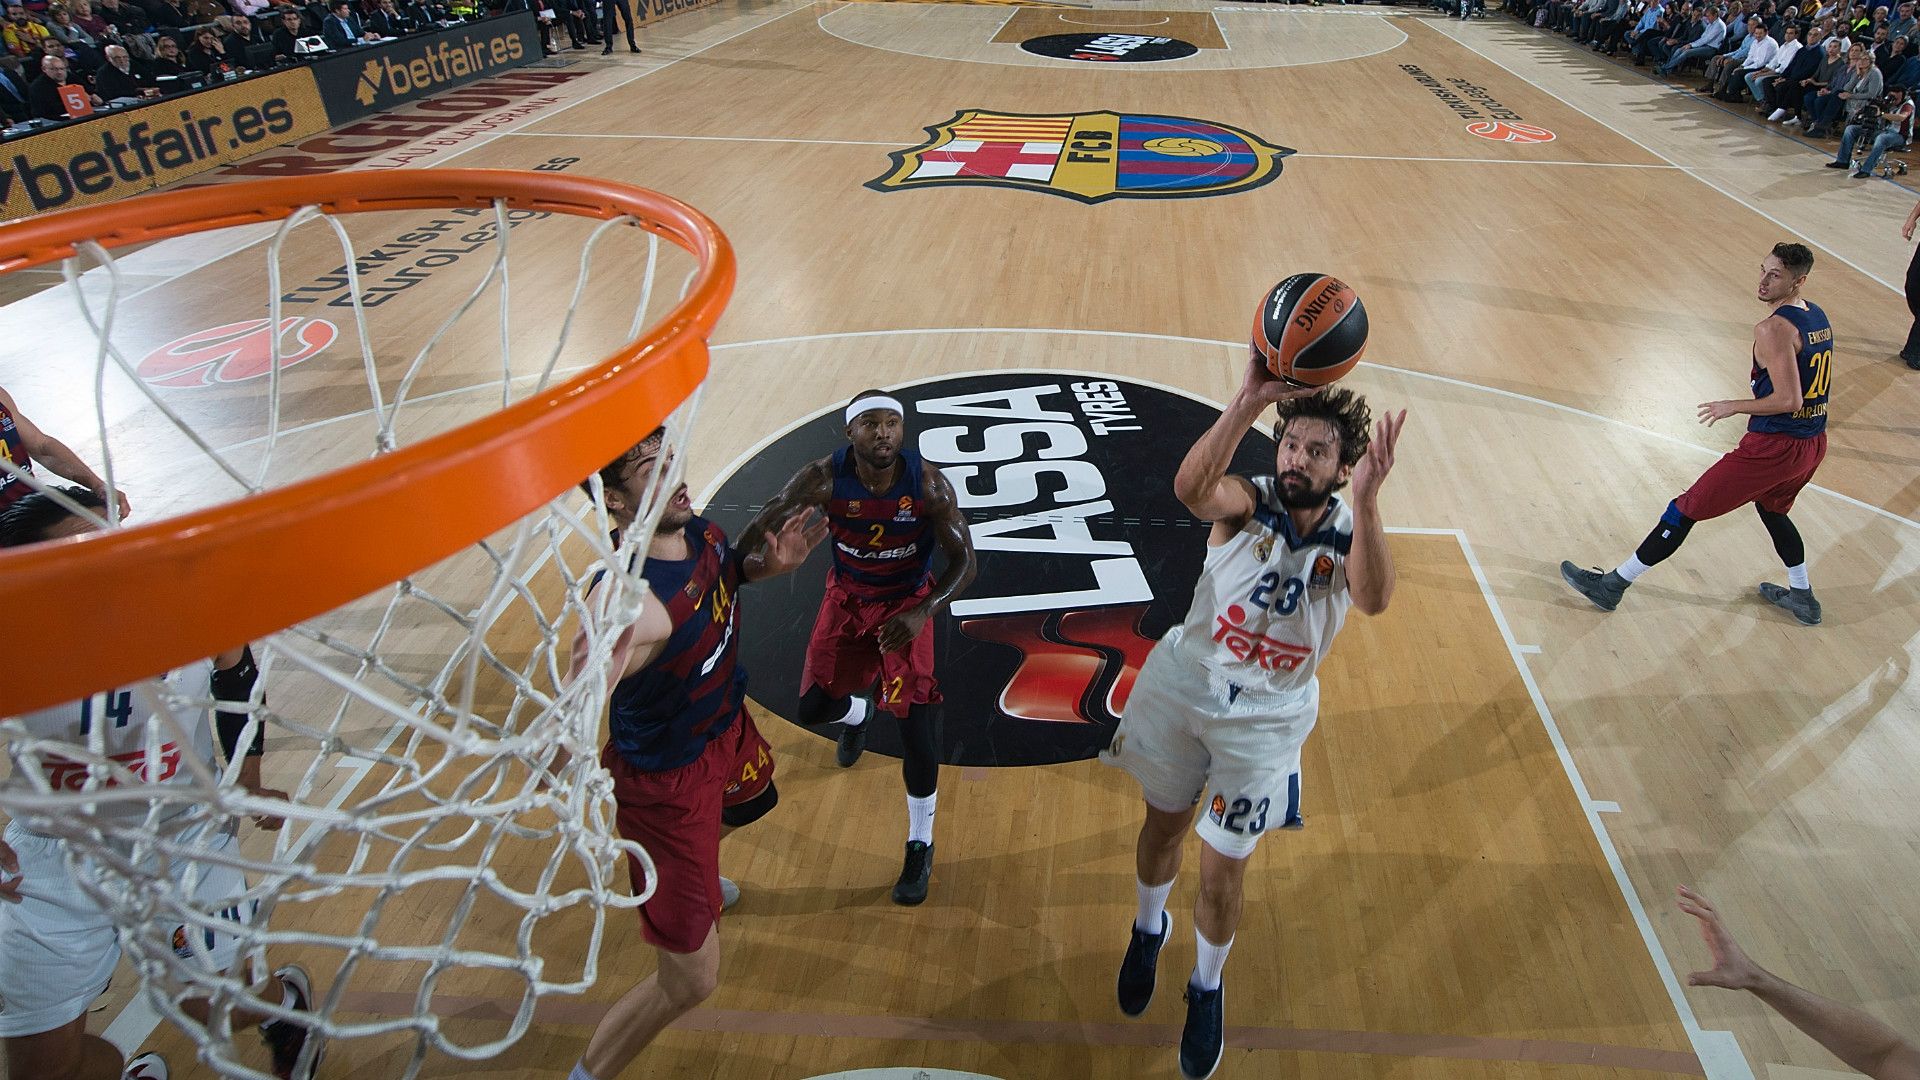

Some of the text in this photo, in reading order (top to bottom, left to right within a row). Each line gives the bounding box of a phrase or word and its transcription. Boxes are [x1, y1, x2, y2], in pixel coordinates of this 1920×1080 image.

[382, 32, 524, 96] betfair.es
[66, 93, 86, 110] 5
[180, 71, 592, 188] RCELONA
[1066, 131, 1112, 163] FCB
[12, 97, 294, 212] betfair.es
[362, 148, 438, 170] LAU
[1804, 350, 1831, 399] 20
[1071, 381, 1142, 436] TYRES
[915, 384, 1154, 616] LASSA
[868, 523, 885, 547] 2
[1250, 572, 1304, 616] 23
[889, 676, 904, 704] 2
[741, 745, 770, 782] 44
[1224, 798, 1271, 835] 23
